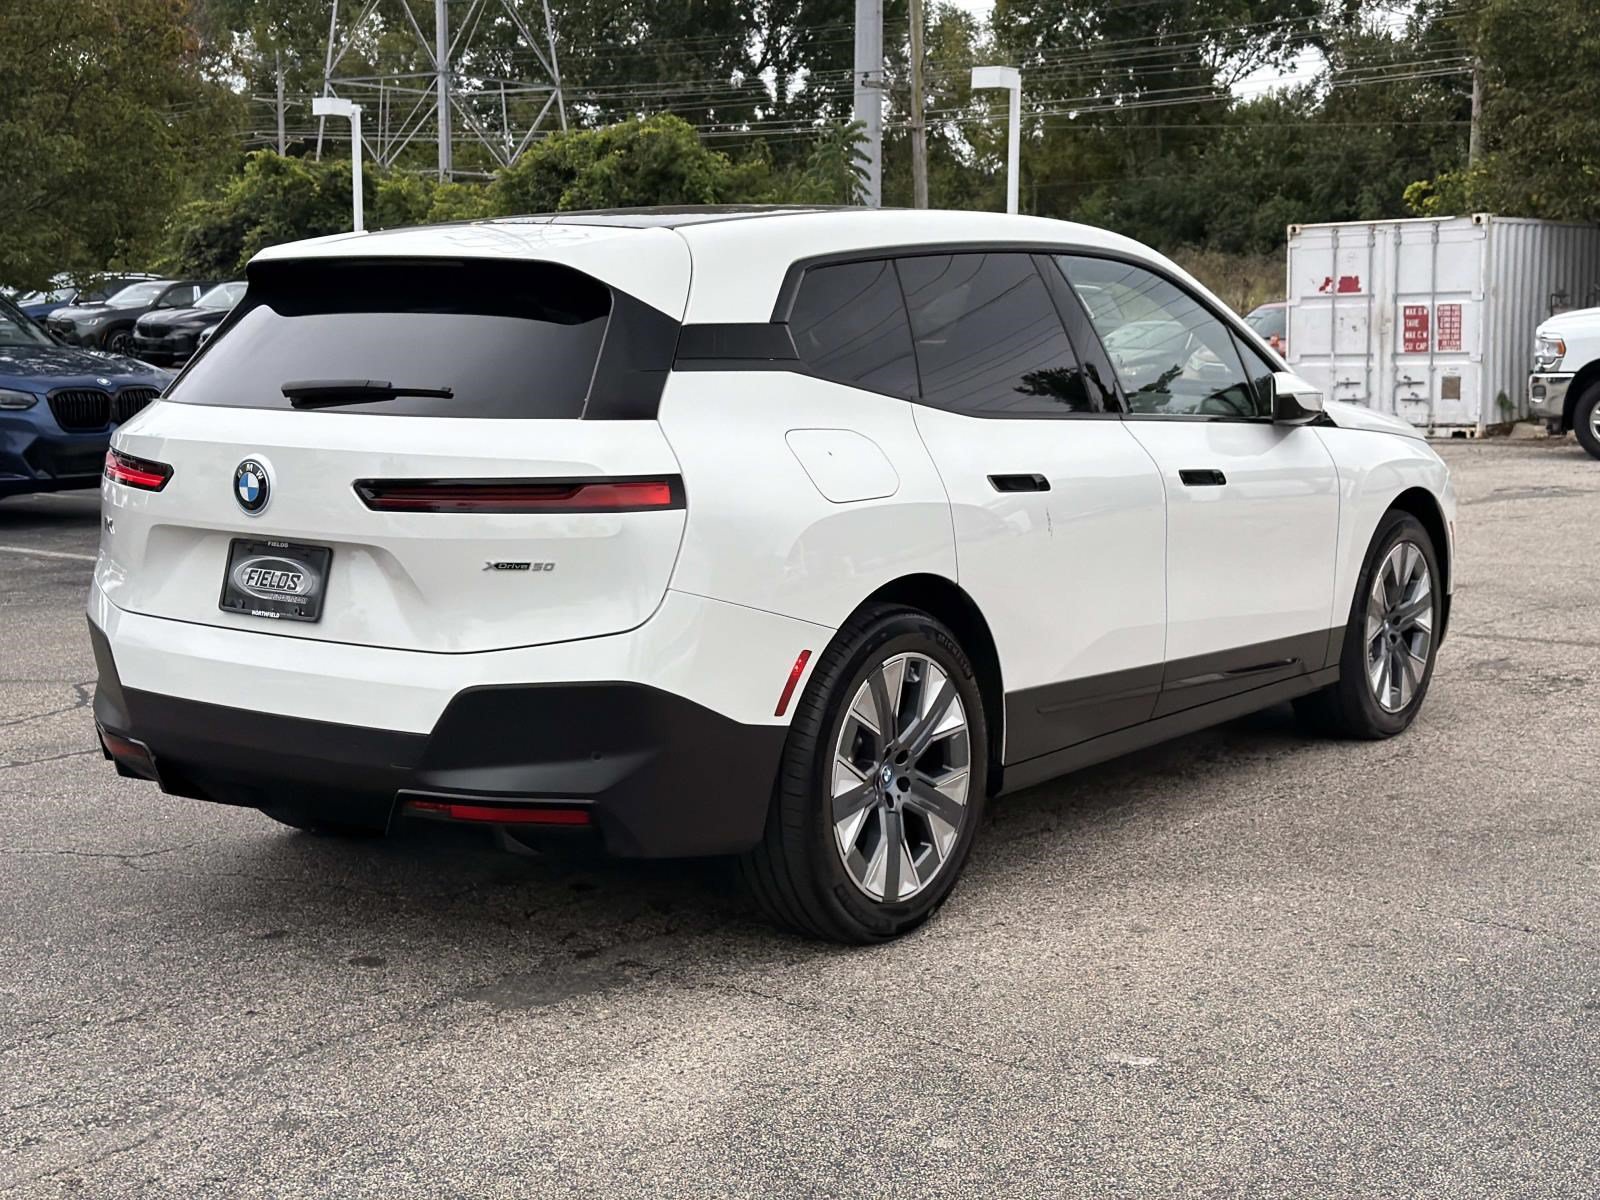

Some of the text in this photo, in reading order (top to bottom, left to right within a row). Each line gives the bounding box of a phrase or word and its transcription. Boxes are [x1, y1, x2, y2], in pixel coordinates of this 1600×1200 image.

[532, 562, 555, 572] 50
[246, 569, 302, 591] FIELDS
[251, 609, 280, 619] NORTHFIELD
